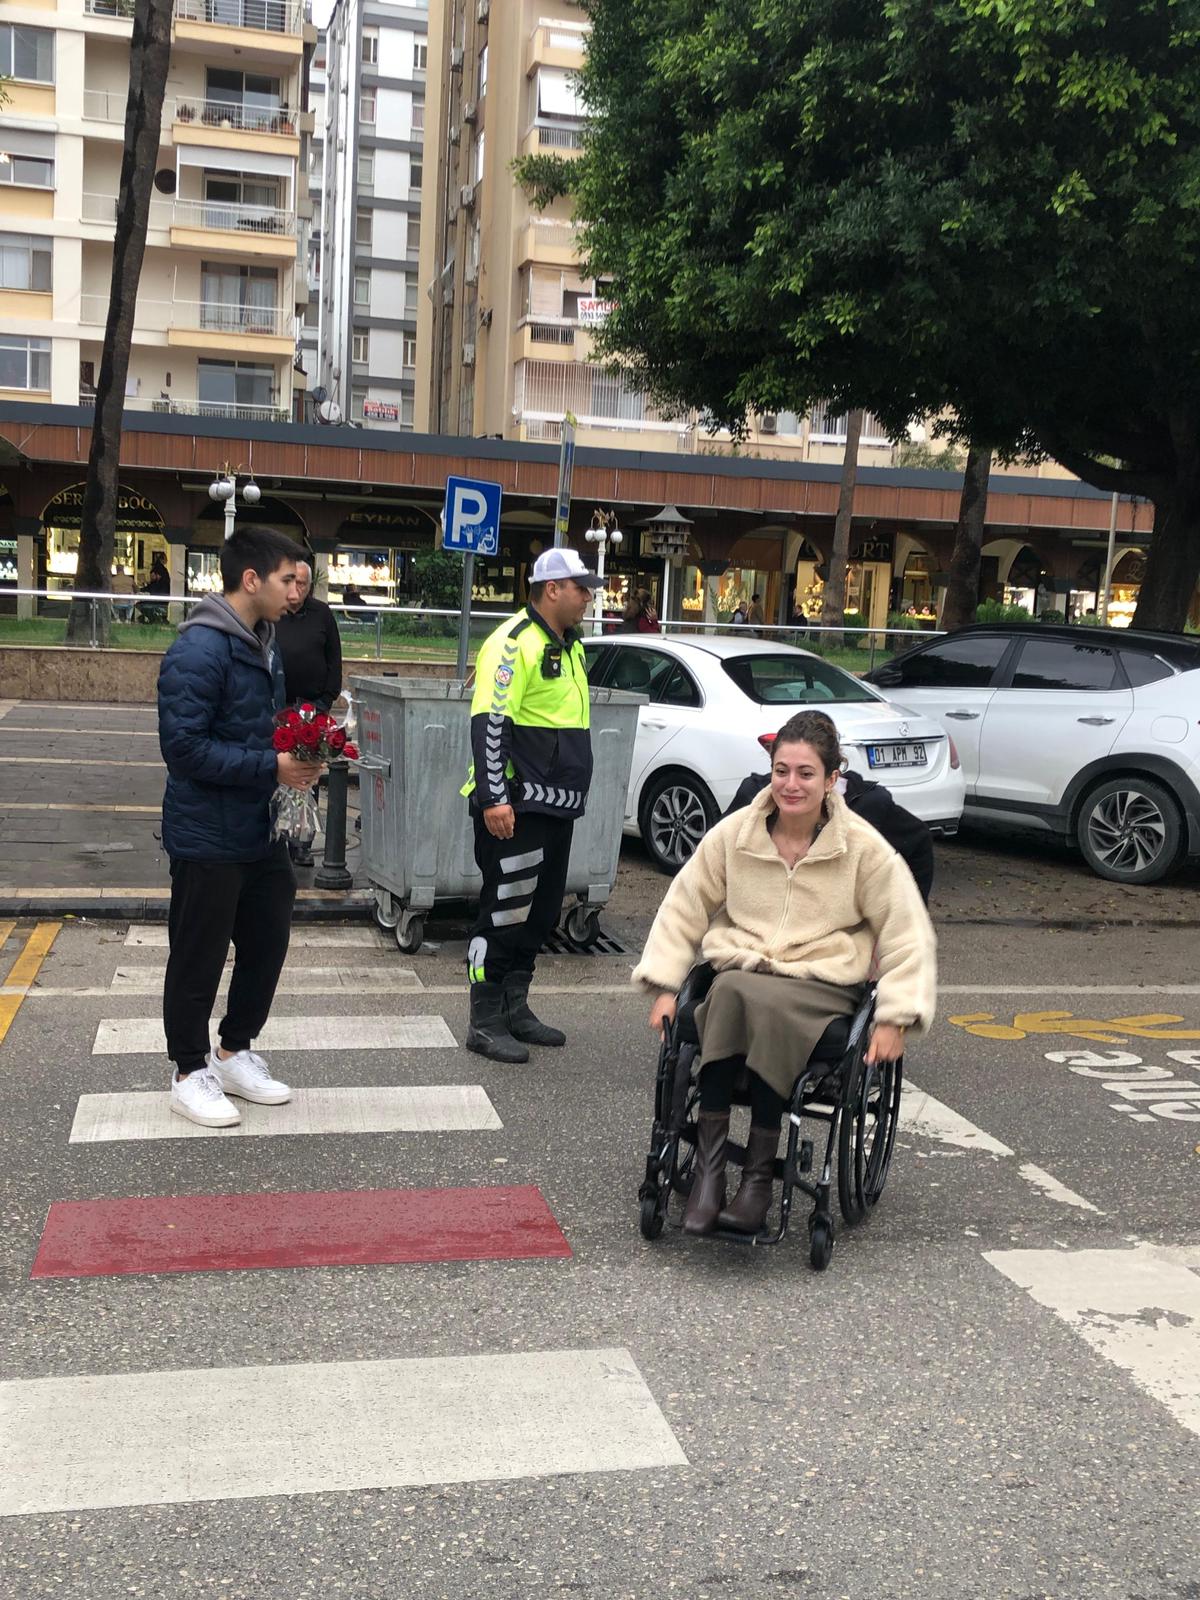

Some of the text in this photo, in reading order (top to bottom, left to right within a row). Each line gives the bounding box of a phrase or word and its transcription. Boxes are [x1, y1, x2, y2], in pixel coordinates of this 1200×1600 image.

[346, 512, 420, 525] EYHAN
[451, 486, 488, 543] P
[874, 744, 925, 763] 01 APM 92
